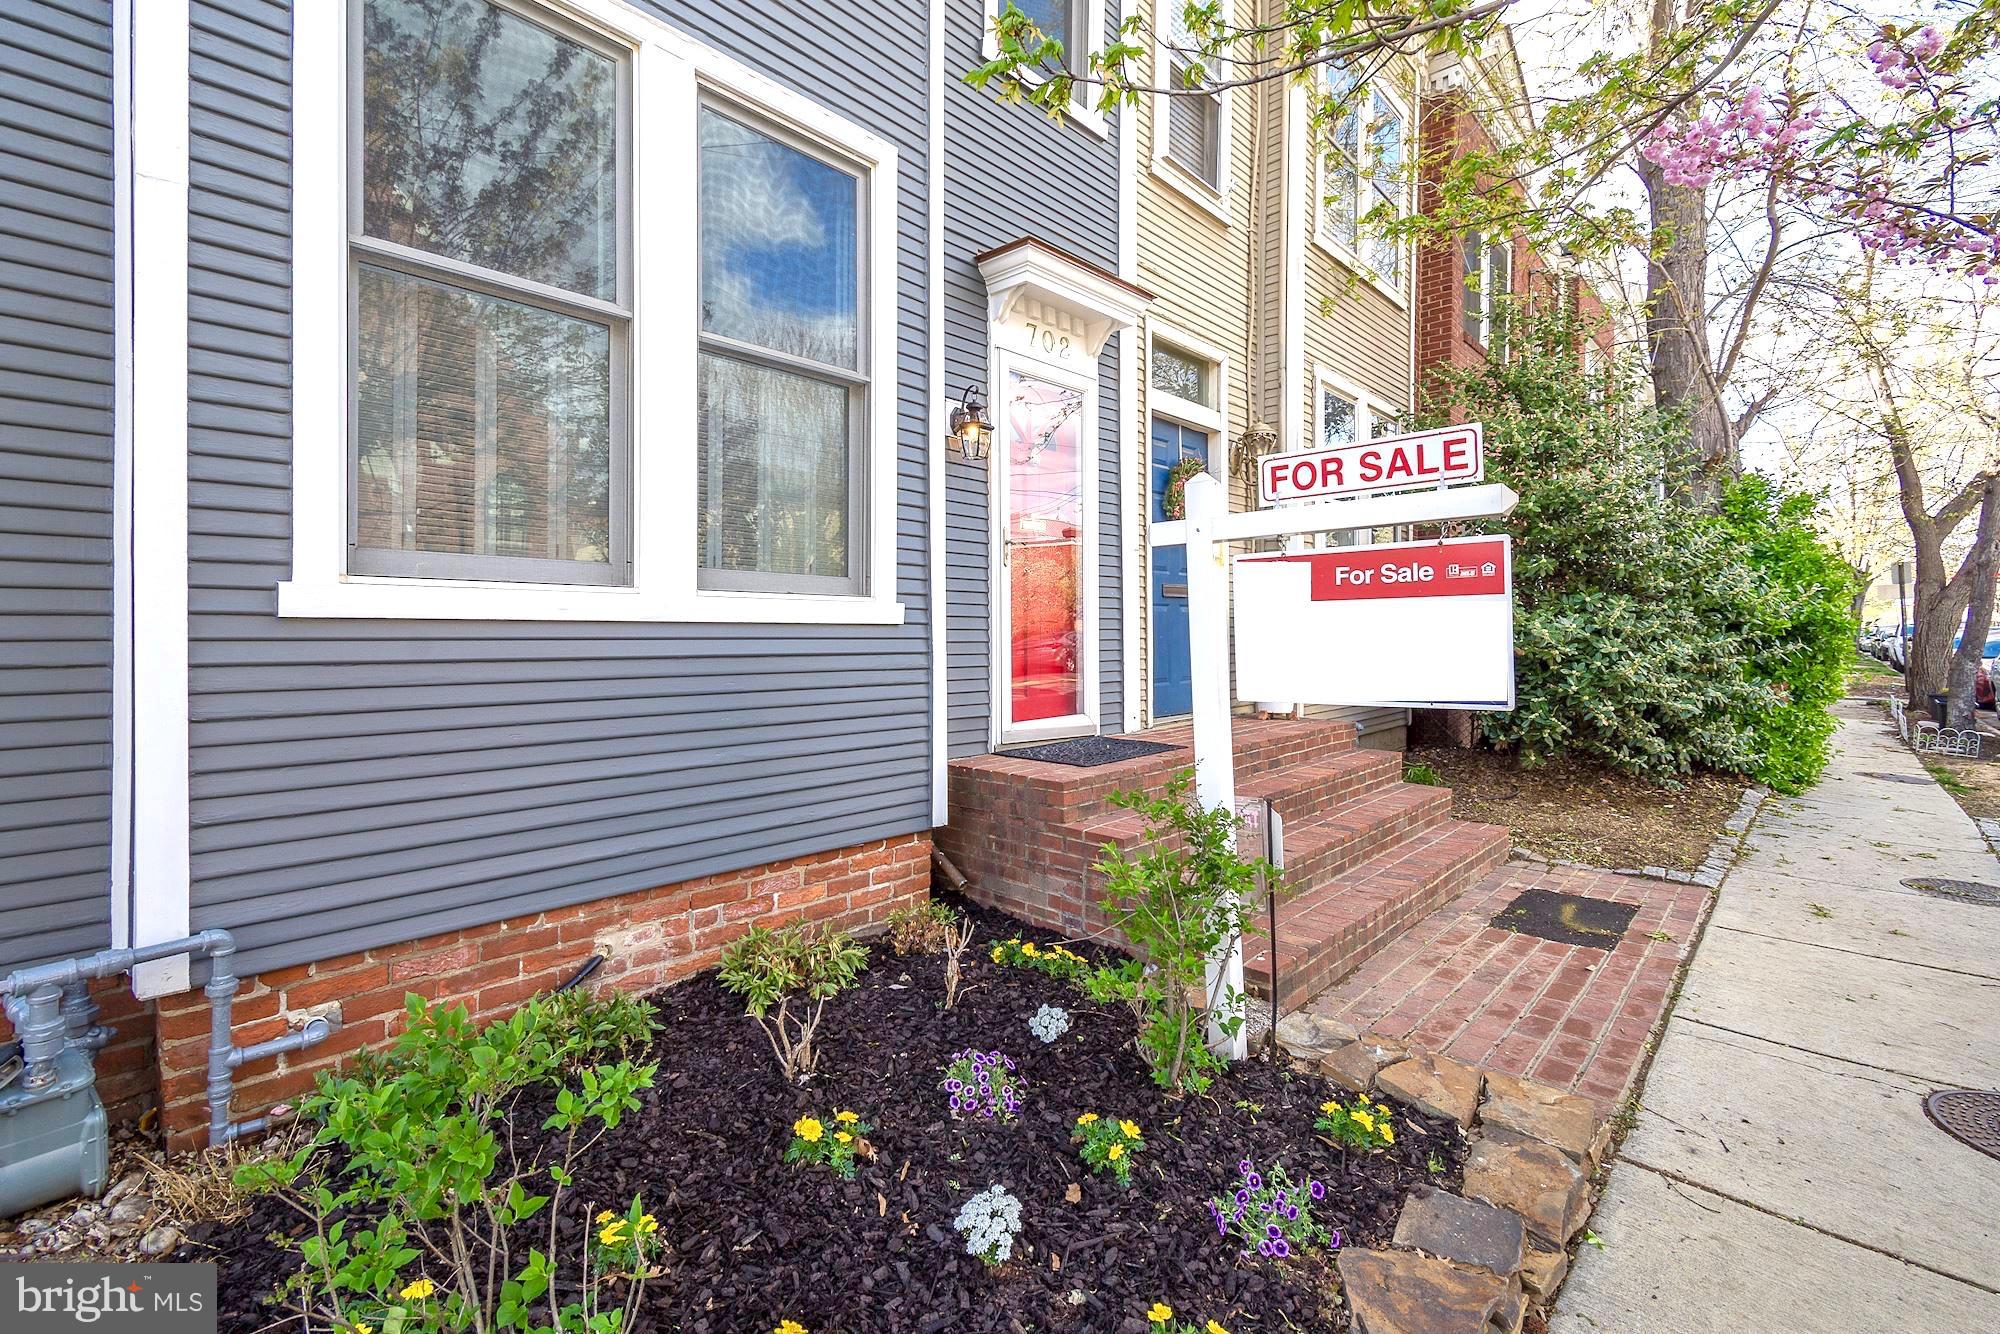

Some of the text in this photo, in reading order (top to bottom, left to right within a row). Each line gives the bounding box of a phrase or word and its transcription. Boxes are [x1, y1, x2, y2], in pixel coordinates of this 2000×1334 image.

[1026, 322, 1070, 359] 702
[1271, 438, 1469, 493] FOR SALE
[1335, 562, 1434, 585] For Sale
